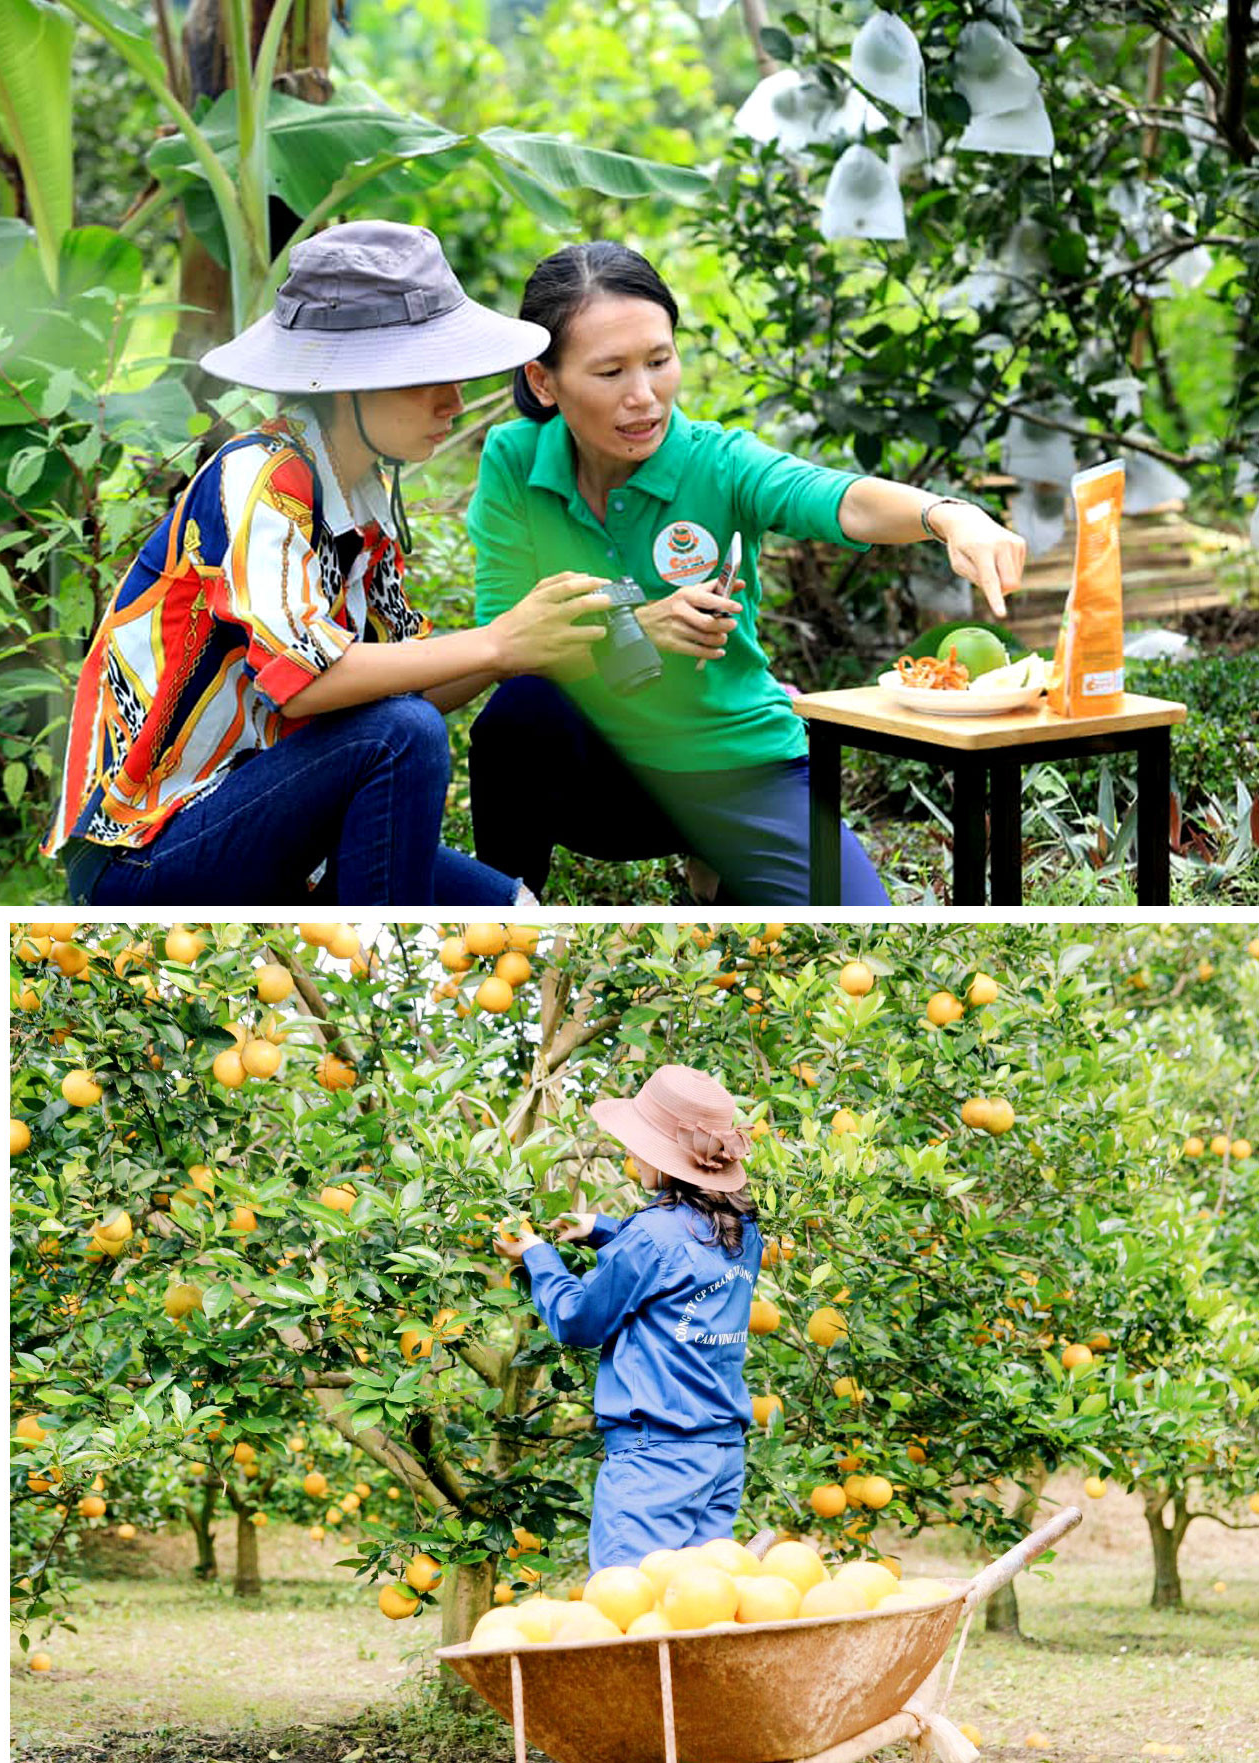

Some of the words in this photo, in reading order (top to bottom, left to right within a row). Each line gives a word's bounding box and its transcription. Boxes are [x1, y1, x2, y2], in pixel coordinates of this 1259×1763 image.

[675, 1314, 692, 1342] CÔNG
[684, 1300, 698, 1315] TY
[694, 1289, 707, 1302] CP
[694, 1331, 717, 1345] CAM
